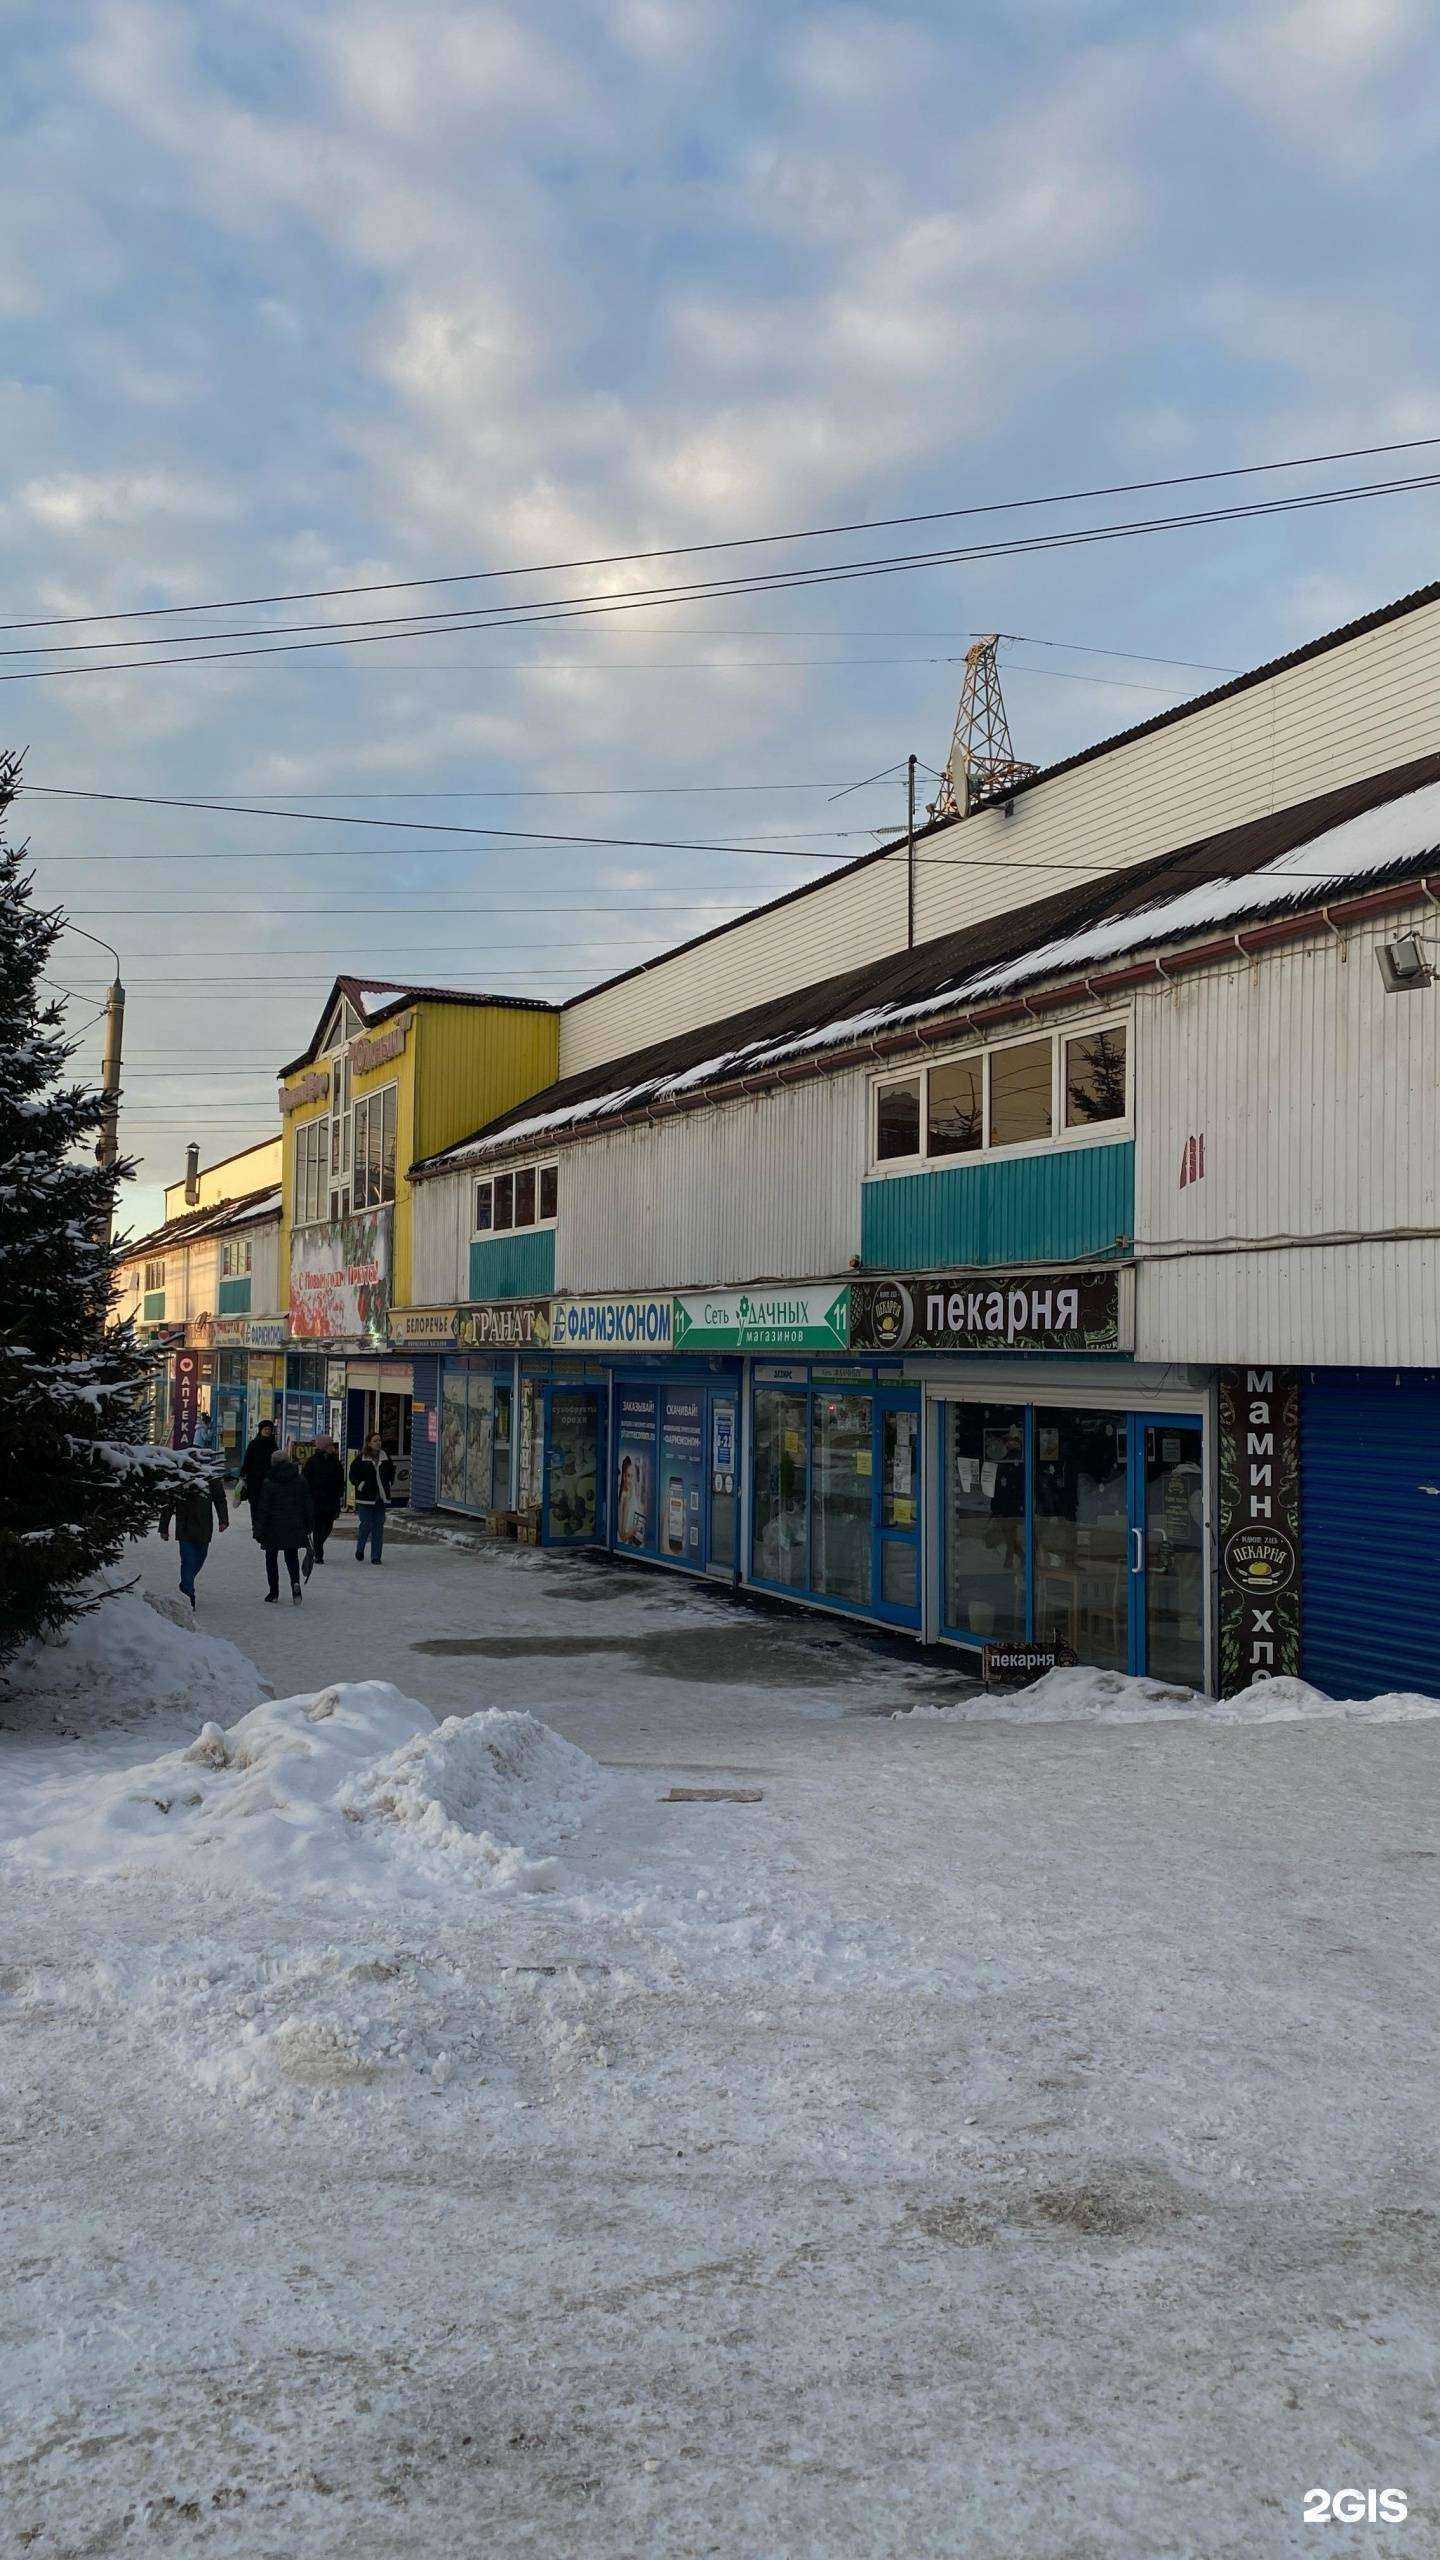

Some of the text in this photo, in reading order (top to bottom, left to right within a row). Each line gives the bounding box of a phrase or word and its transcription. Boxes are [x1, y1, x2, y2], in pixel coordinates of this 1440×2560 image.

[406, 1316, 448, 1333] БЕЛОРЕЧЬЕ
[568, 1303, 671, 1341] ФАРМЭКОНОМ
[704, 1303, 730, 1325] Сеть
[926, 1288, 1078, 1344] пекарня
[472, 1309, 535, 1342] ГРАНАТ
[746, 1330, 804, 1342] магазинов
[181, 1376, 190, 1443] АПТЕКА
[1233, 1545, 1287, 1563] ПЕКАРНЯ
[991, 1653, 1055, 1670] пекарня
